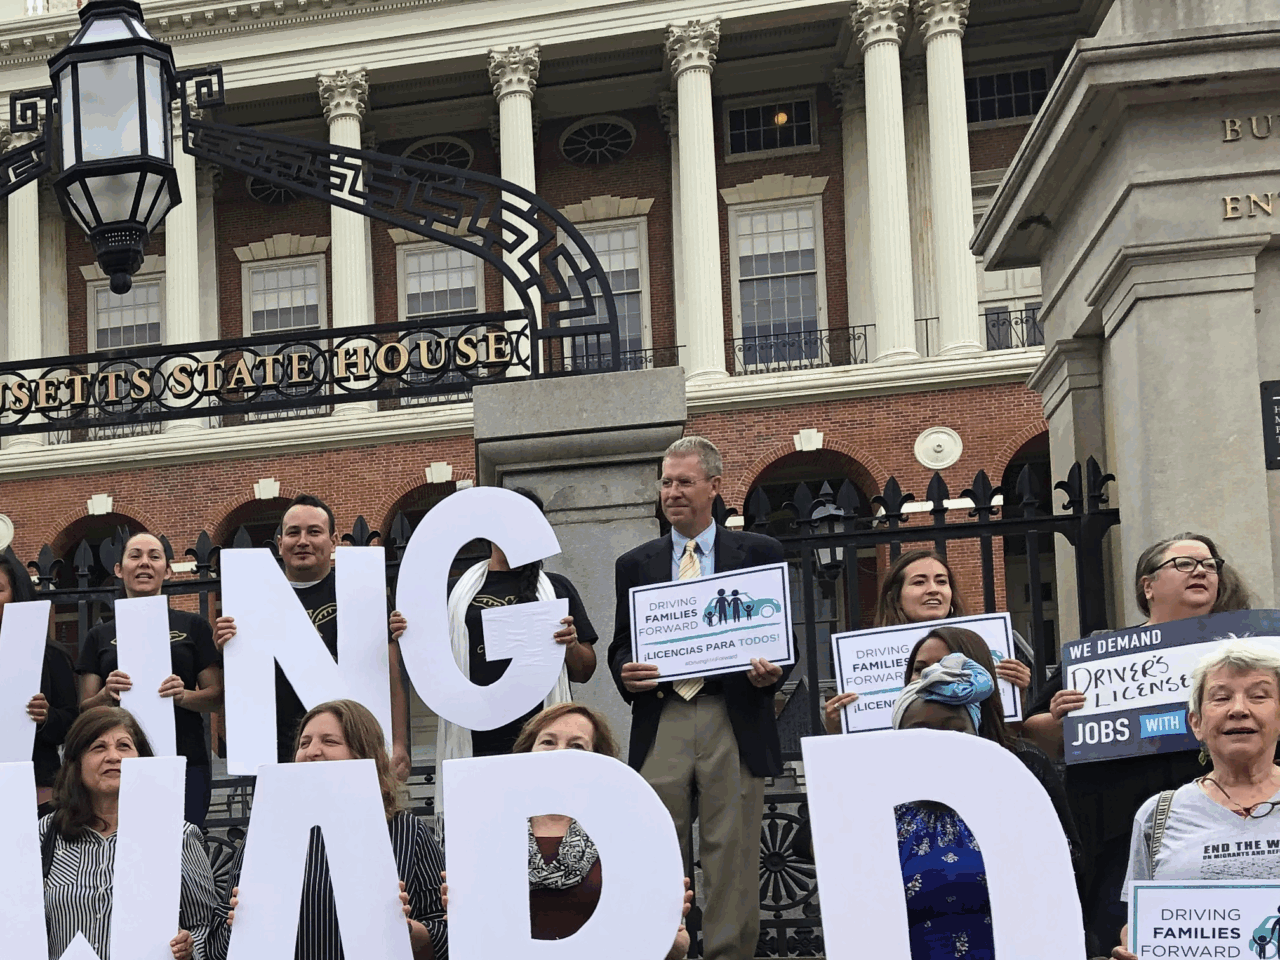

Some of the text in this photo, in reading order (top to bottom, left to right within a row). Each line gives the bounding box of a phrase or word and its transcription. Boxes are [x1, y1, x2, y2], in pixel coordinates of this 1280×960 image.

[1222, 115, 1280, 142] BU
[1222, 192, 1280, 221] EN
[170, 352, 312, 398] STATE
[334, 331, 513, 382] HOUSE
[649, 597, 697, 611] DRIVING
[645, 609, 698, 623] FAMILIES
[639, 621, 698, 637] FORWARD
[706, 640, 736, 652] PARA
[738, 634, 780, 647] TODOS!
[1070, 629, 1162, 659] WE DEMAND
[856, 645, 910, 660] DRIVING
[846, 671, 906, 686] FORWAR
[1095, 674, 1191, 707] LICENSE
[1071, 715, 1180, 746] JOBS WITH
[1204, 845, 1230, 854] END
[1235, 841, 1262, 851] THE
[1214, 851, 1250, 859] MIGRANTS
[1161, 908, 1241, 921] DRIVING
[1153, 927, 1241, 940] FAMILIES
[1141, 945, 1241, 958] FORWARD
